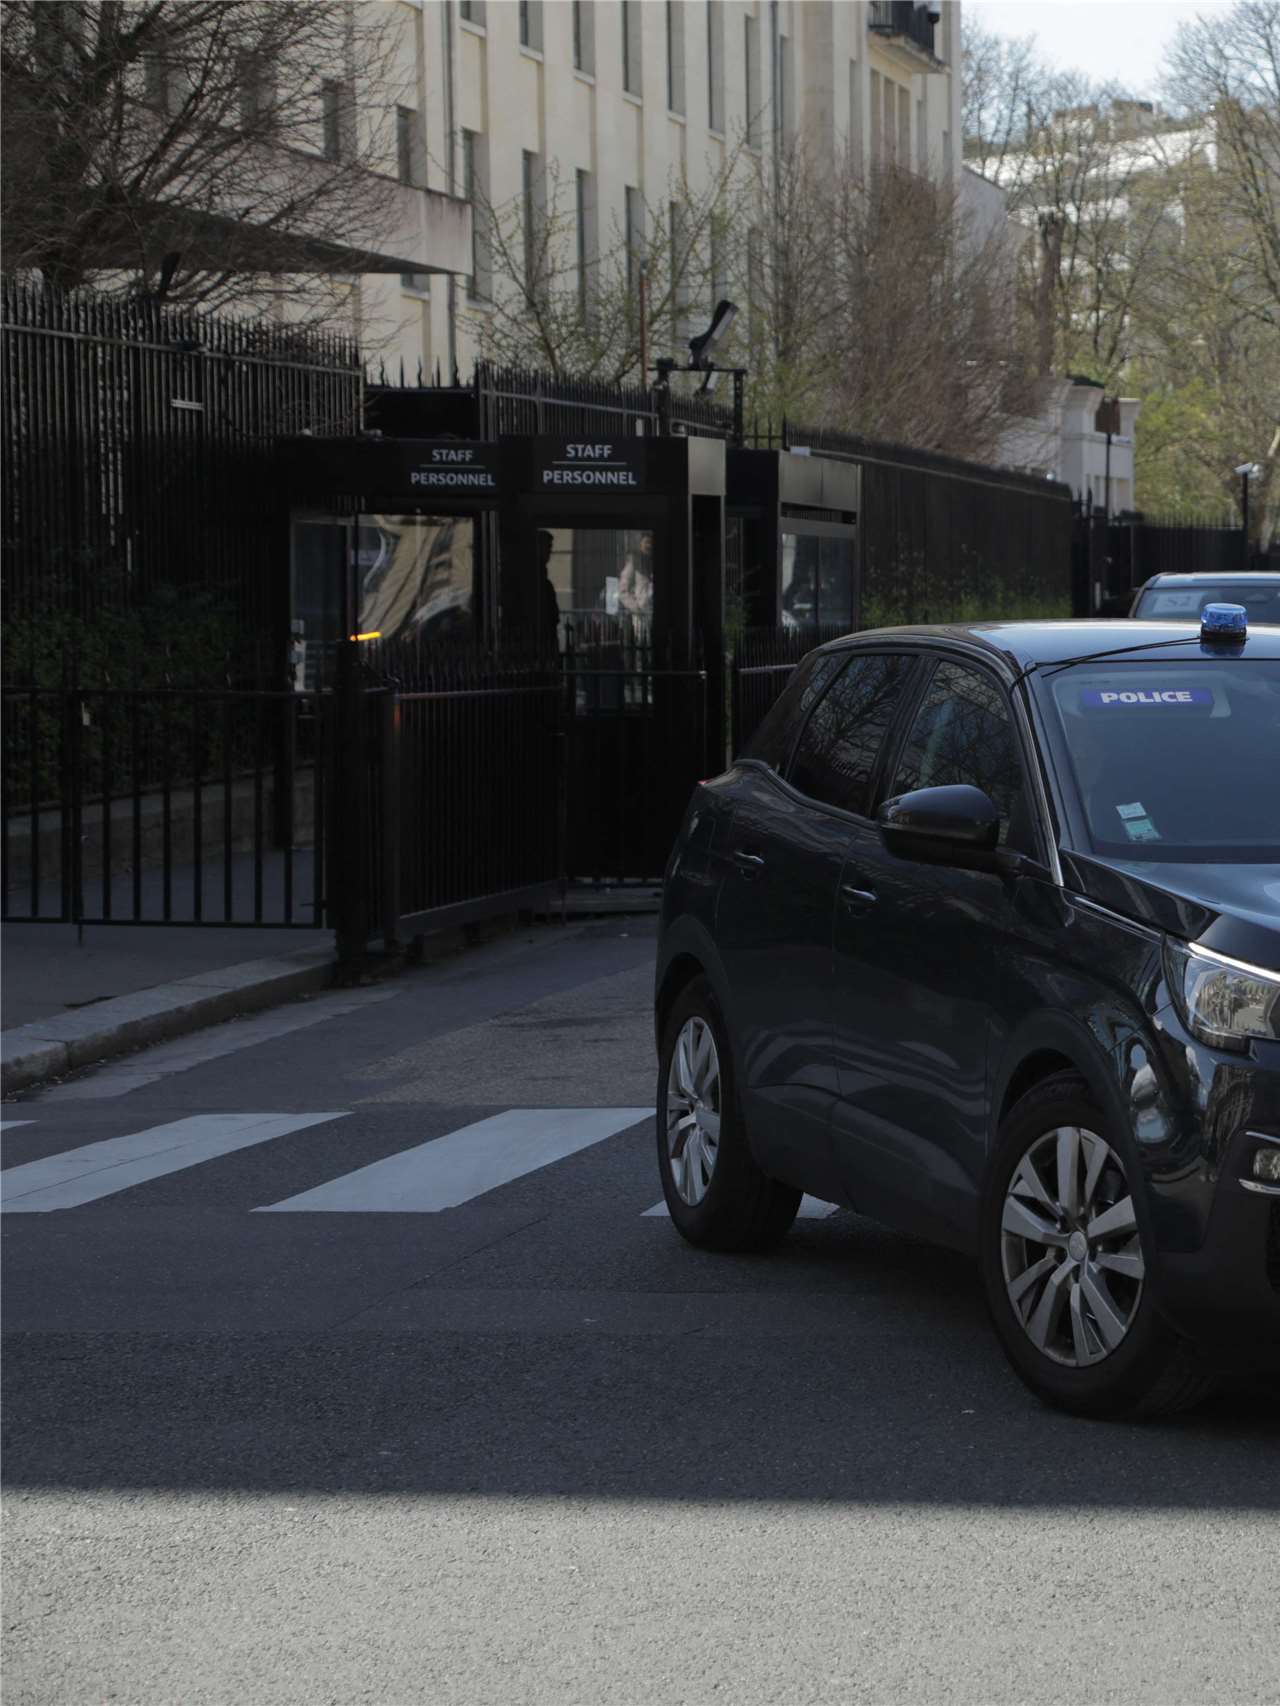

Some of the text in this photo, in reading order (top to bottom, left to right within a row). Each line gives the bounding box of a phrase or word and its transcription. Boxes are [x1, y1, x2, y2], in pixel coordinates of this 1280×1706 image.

[431, 449, 474, 462] STAFF
[566, 444, 613, 459] STAFF
[410, 472, 496, 487] PERSONNEL
[542, 470, 637, 485] PERSONNEL
[1100, 691, 1193, 704] POLICE
